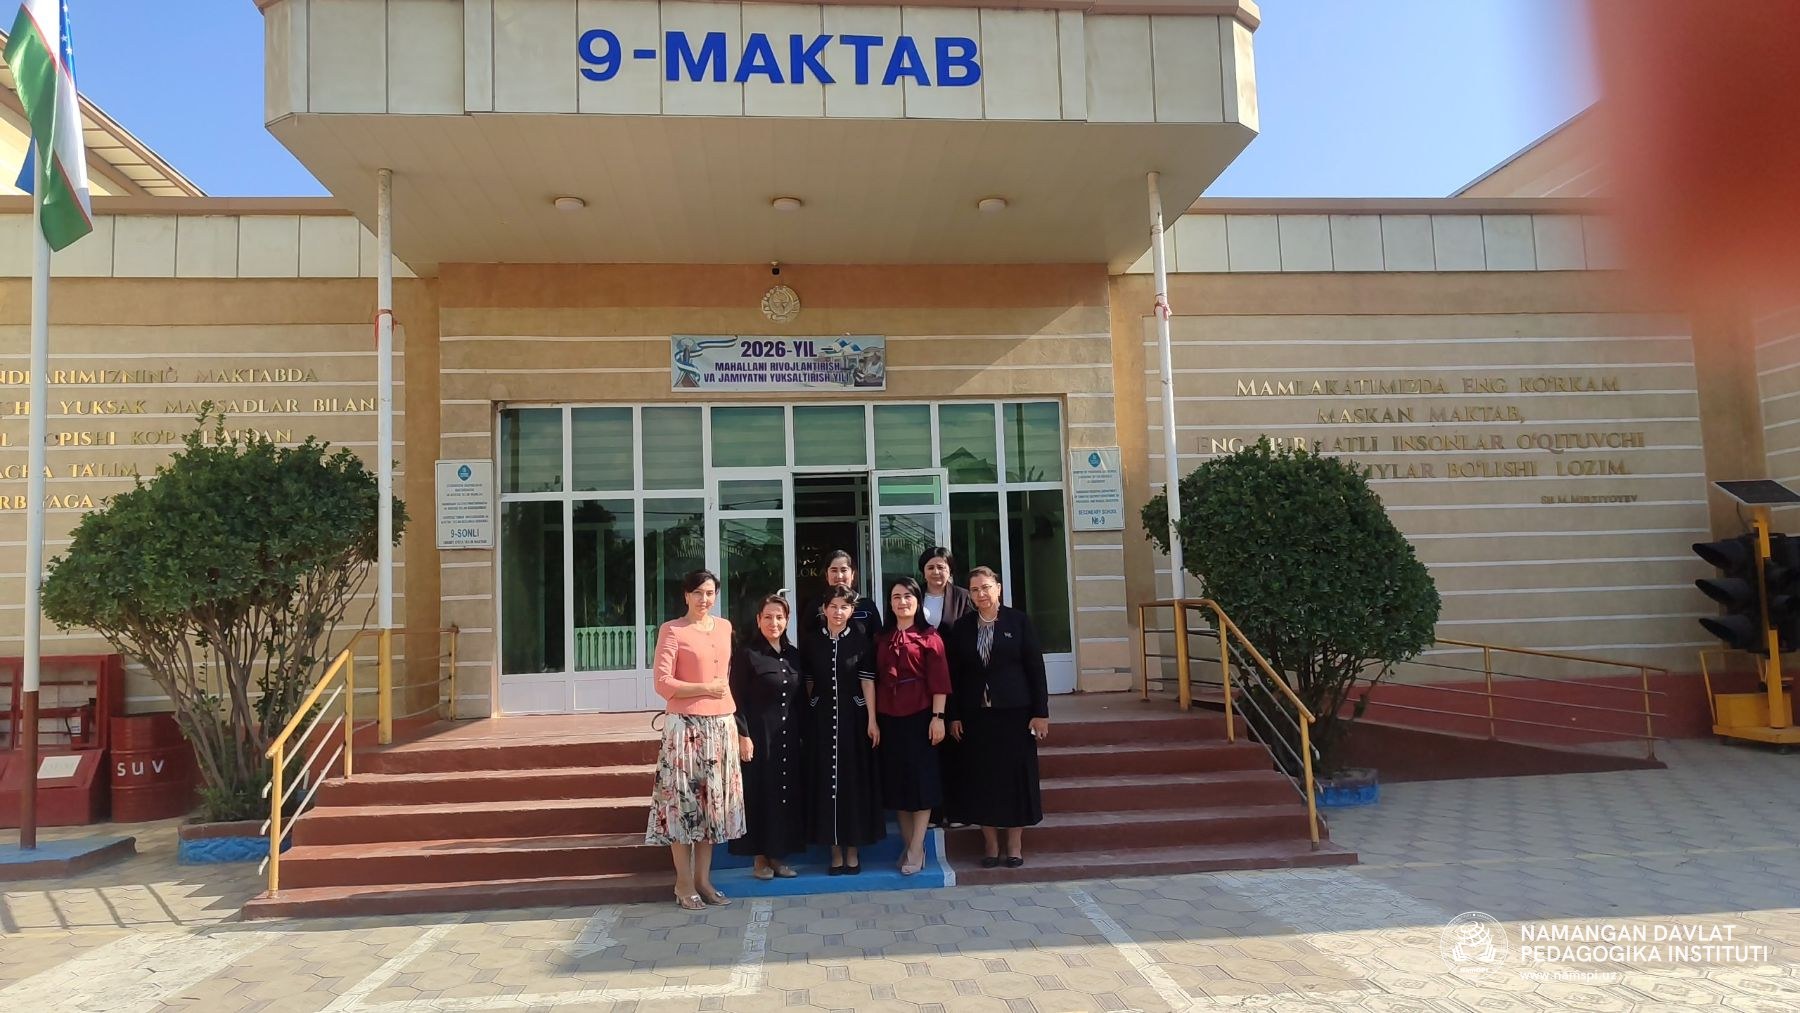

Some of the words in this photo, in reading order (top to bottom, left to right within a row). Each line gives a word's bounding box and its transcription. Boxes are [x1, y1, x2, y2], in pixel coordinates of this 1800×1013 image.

[740, 340, 817, 357] 2026-YIL
[715, 362, 767, 371] MAHALLANI
[770, 361, 840, 371] RIVOJLANTIRISH
[195, 368, 319, 383] MAKTABDA
[704, 373, 715, 382] VA
[718, 373, 767, 382] JAMIYATNI
[770, 373, 829, 382] YUKSALTIRISH
[1462, 377, 1509, 393] ENG
[60, 399, 147, 415] YUKSAK
[313, 397, 375, 412] BILAN
[1316, 407, 1415, 423] MASKAN
[44, 432, 117, 446] OPISHI
[1197, 436, 1244, 453] ENG
[1392, 434, 1505, 451] INSONLAR
